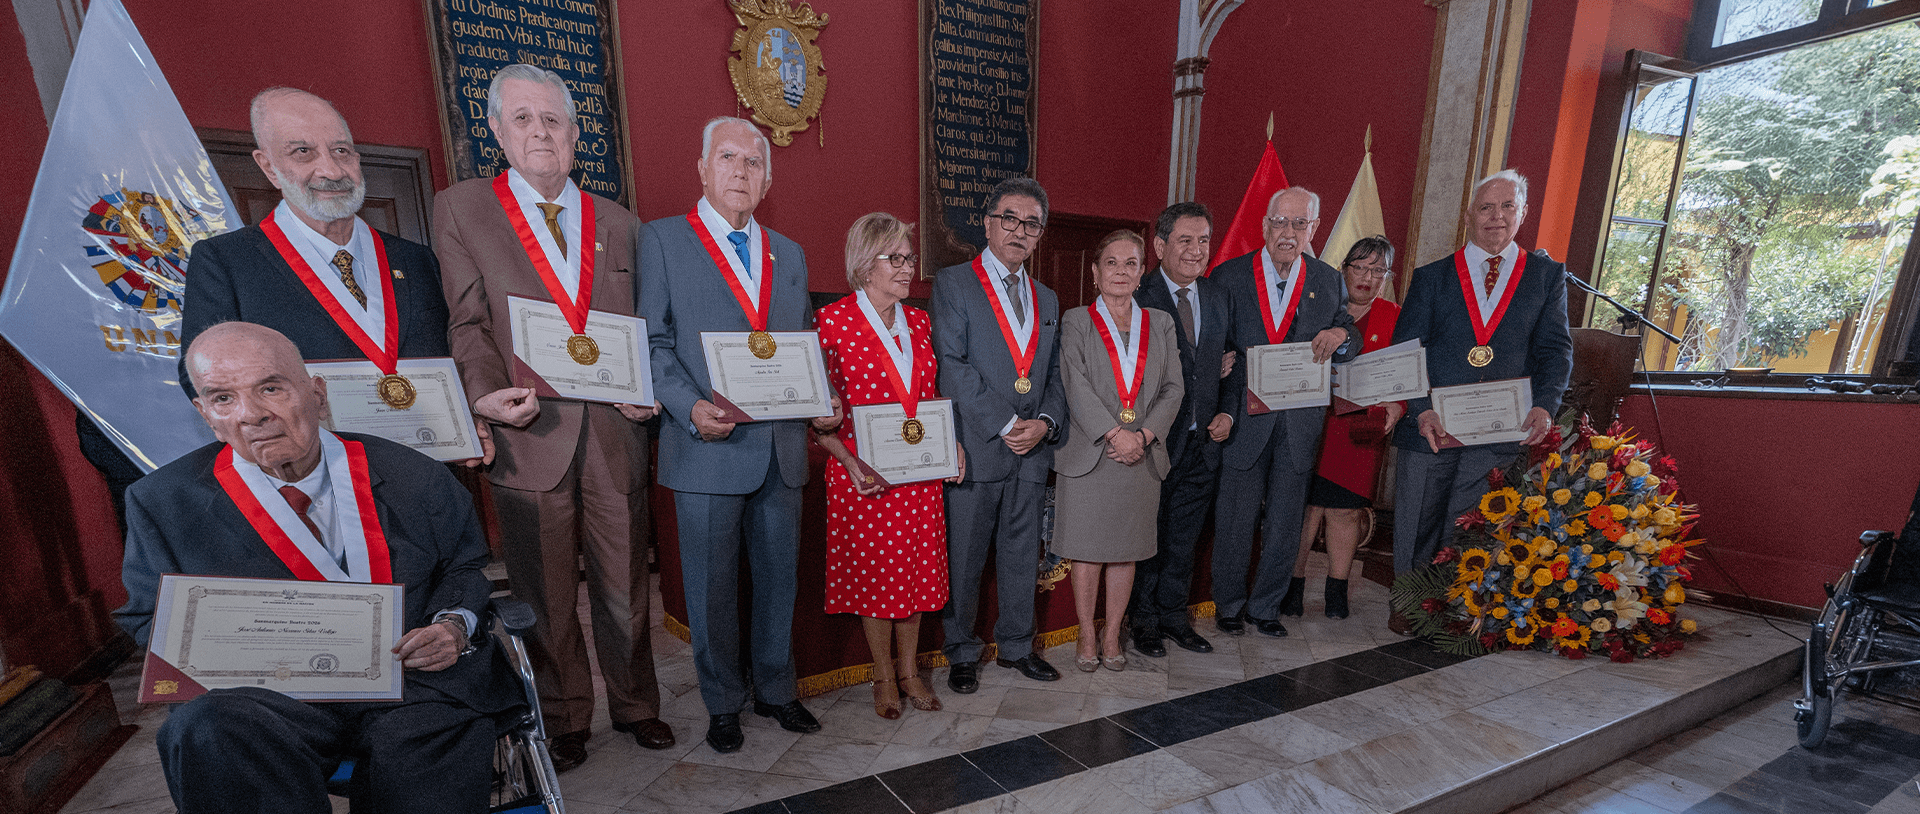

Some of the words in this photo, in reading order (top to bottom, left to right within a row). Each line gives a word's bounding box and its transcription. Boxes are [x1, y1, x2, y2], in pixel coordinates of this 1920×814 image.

[470, 0, 517, 21] Ordinis
[453, 17, 505, 41] ejusdem
[456, 41, 509, 62] traducta
[575, 60, 598, 78] que
[459, 63, 488, 85] regia
[937, 90, 948, 103] de
[471, 122, 488, 138] do
[997, 131, 1019, 147] hanc
[579, 171, 617, 193] Anno
